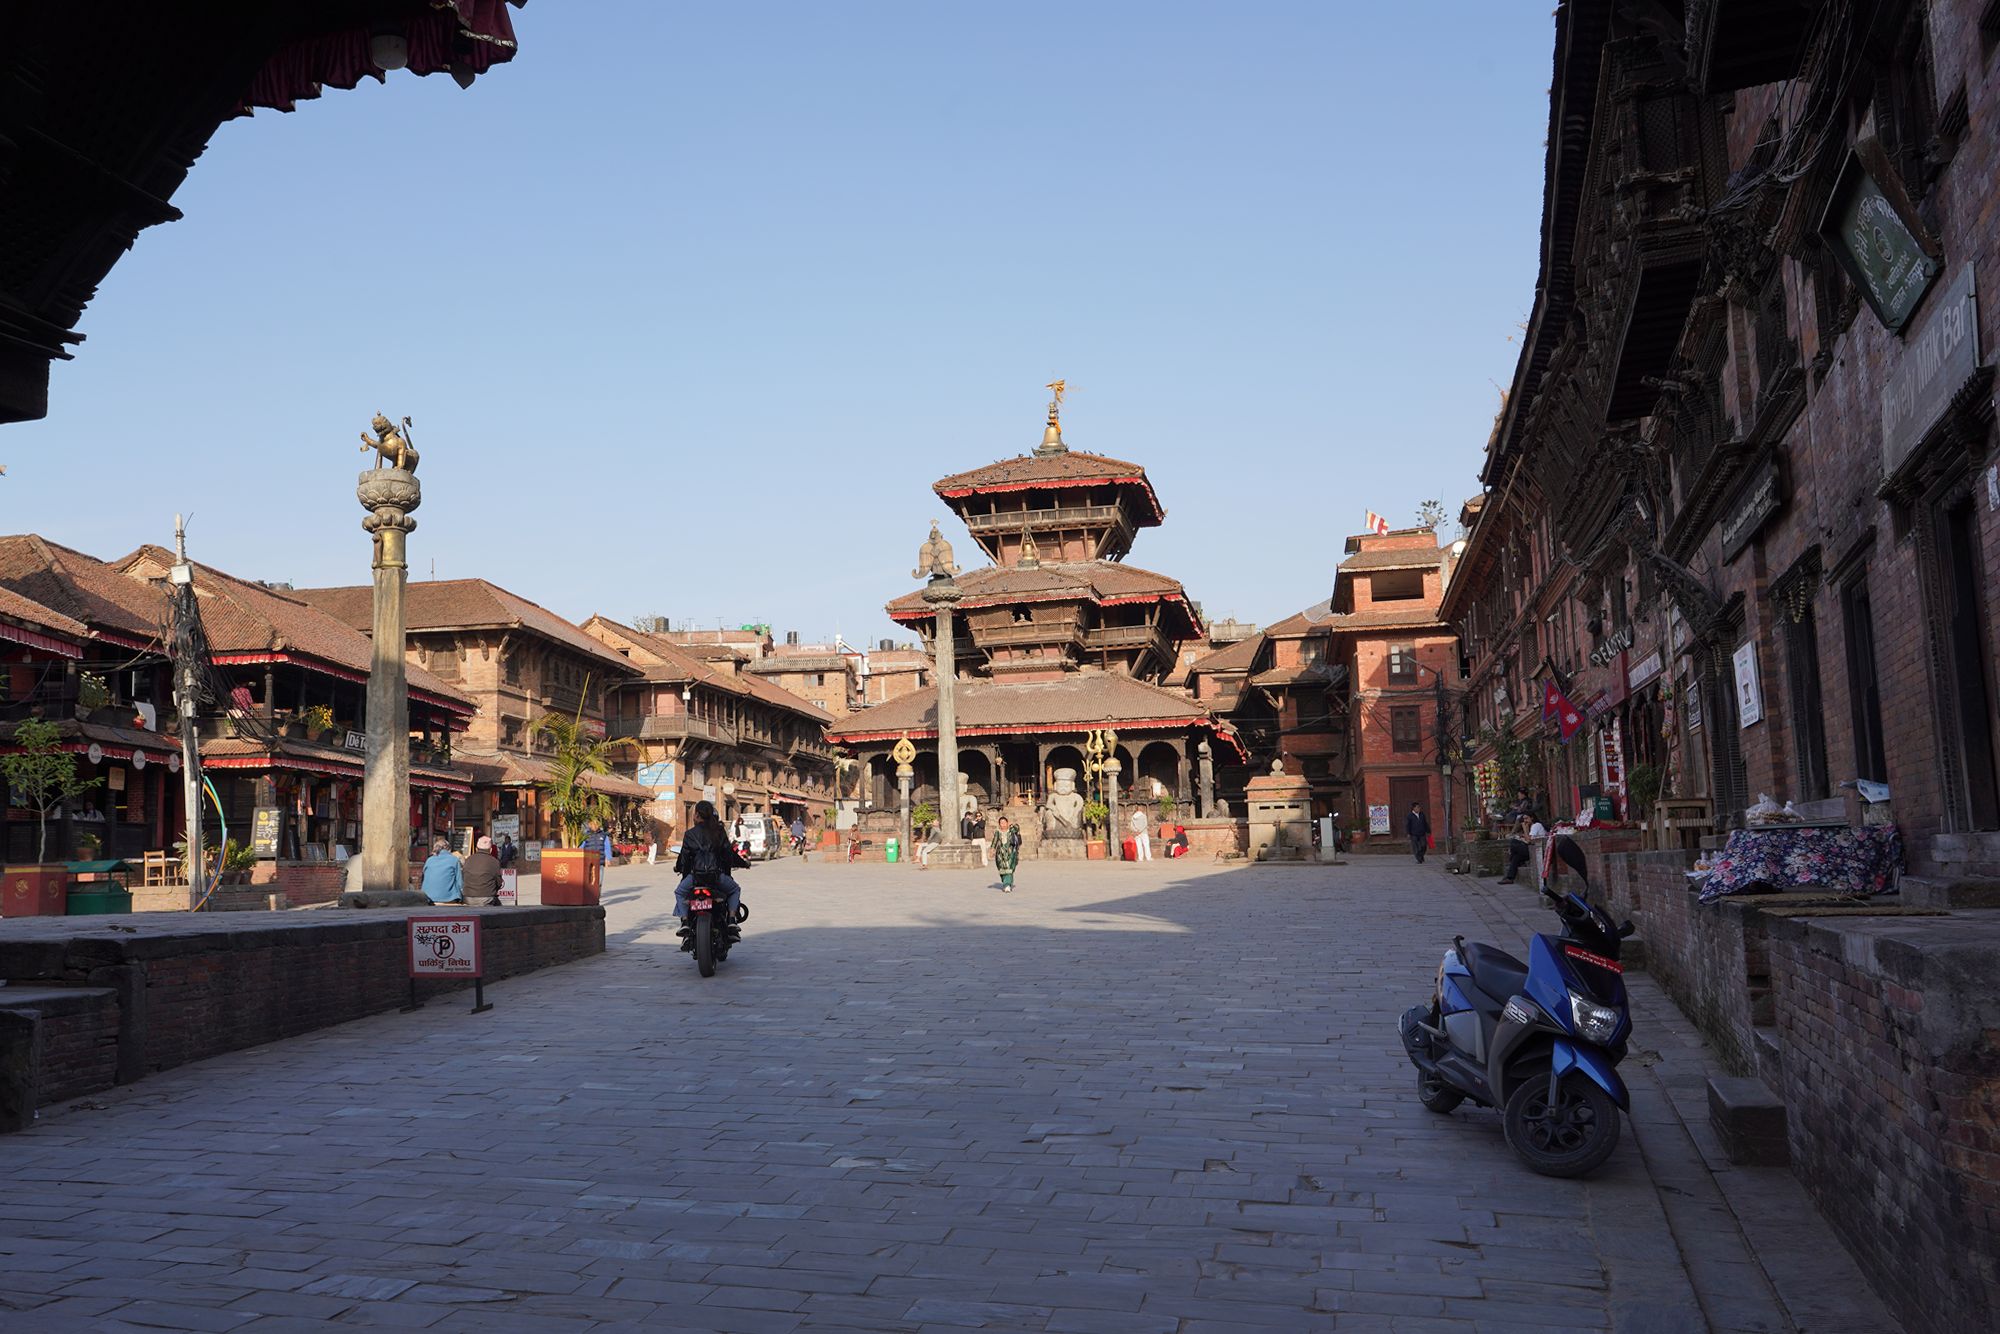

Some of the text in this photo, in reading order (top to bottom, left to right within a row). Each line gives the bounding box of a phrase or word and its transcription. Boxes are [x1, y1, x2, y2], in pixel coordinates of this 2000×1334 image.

[1916, 331, 1941, 394] Milk
[1942, 295, 1967, 360] Bar
[451, 922, 470, 934] क्षेत्र
